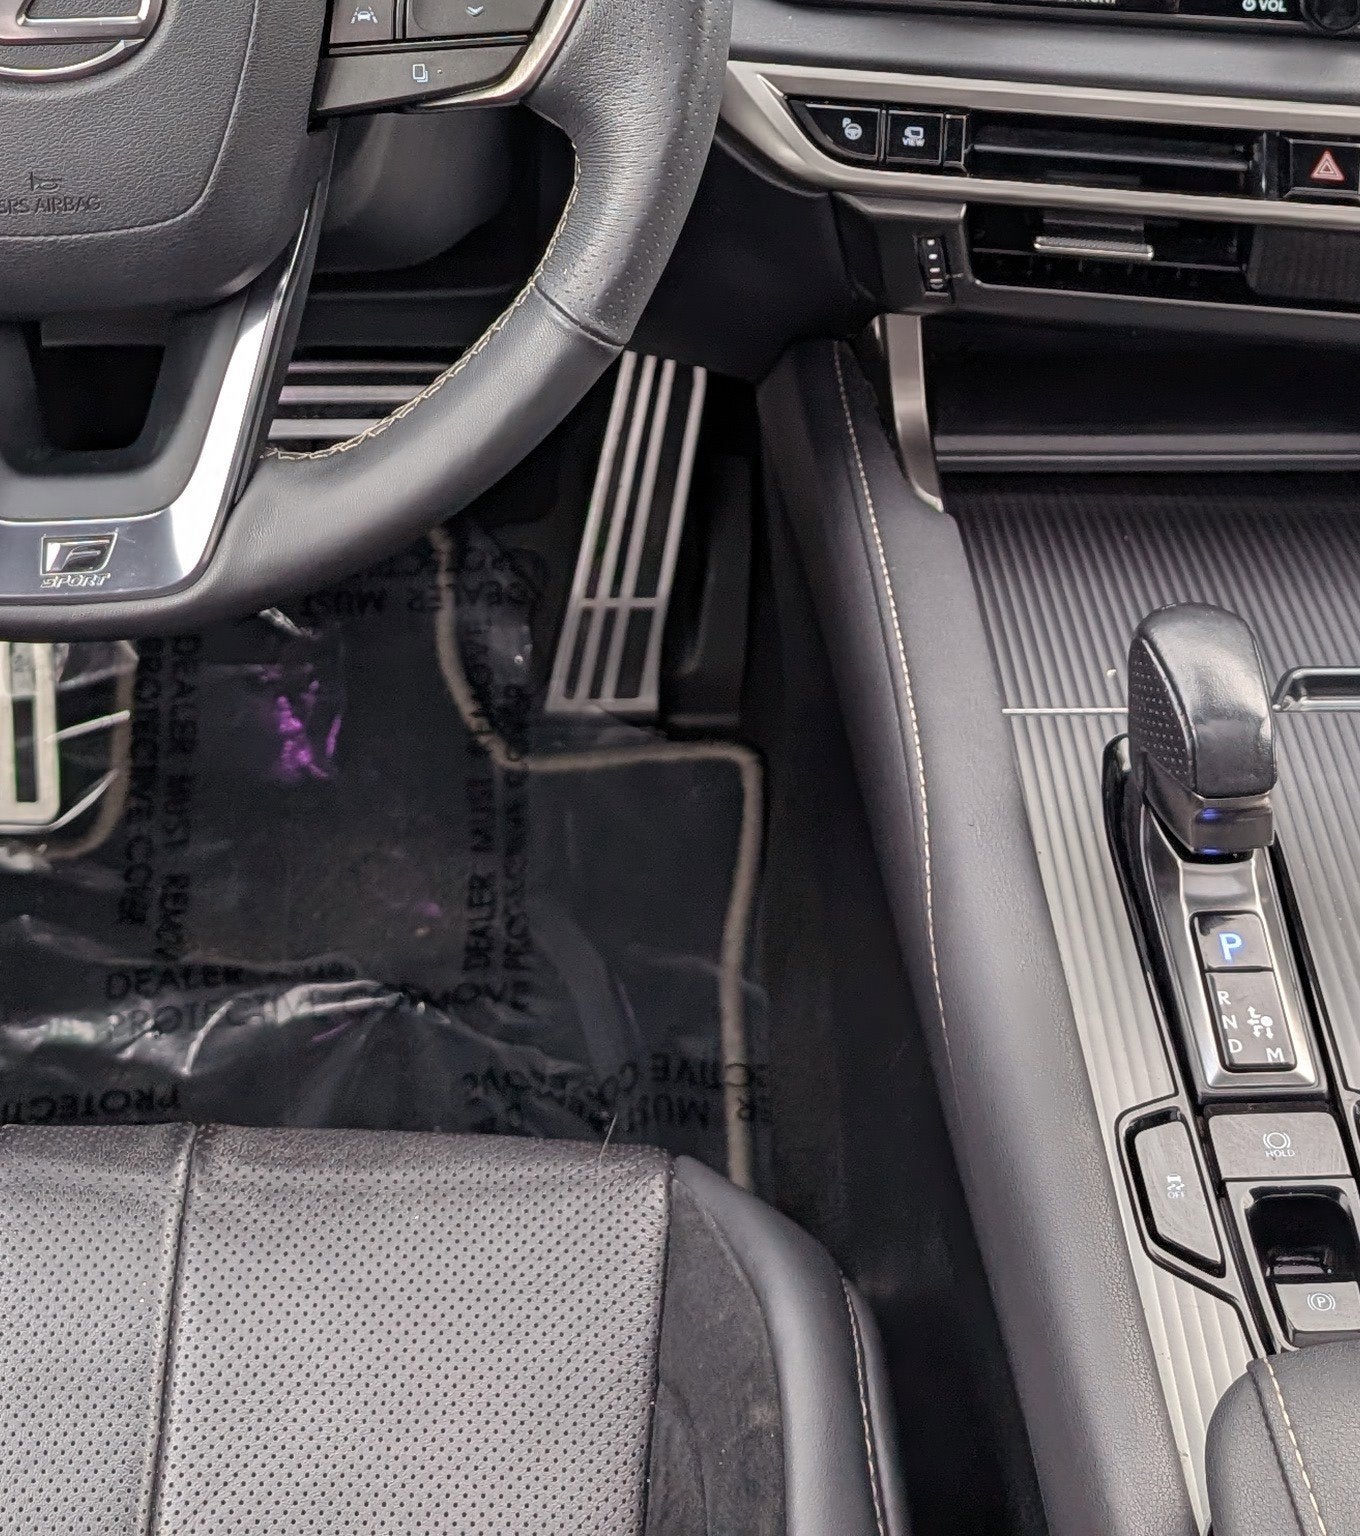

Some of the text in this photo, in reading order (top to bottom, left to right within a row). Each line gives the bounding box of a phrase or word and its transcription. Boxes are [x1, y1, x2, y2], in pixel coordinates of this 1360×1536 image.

[902, 137, 925, 147] VIEW
[35, 194, 101, 215] AIRBAG
[40, 572, 111, 589] SPORT
[168, 634, 202, 754] DEALER
[1219, 932, 1243, 960] P
[1218, 990, 1232, 1006] R
[1222, 1014, 1238, 1030] N
[1228, 1038, 1244, 1055] D
[1266, 1047, 1286, 1064] M
[1264, 1149, 1295, 1158] HOLD
[1168, 1191, 1185, 1199] OFF
[1316, 1297, 1326, 1307] P
